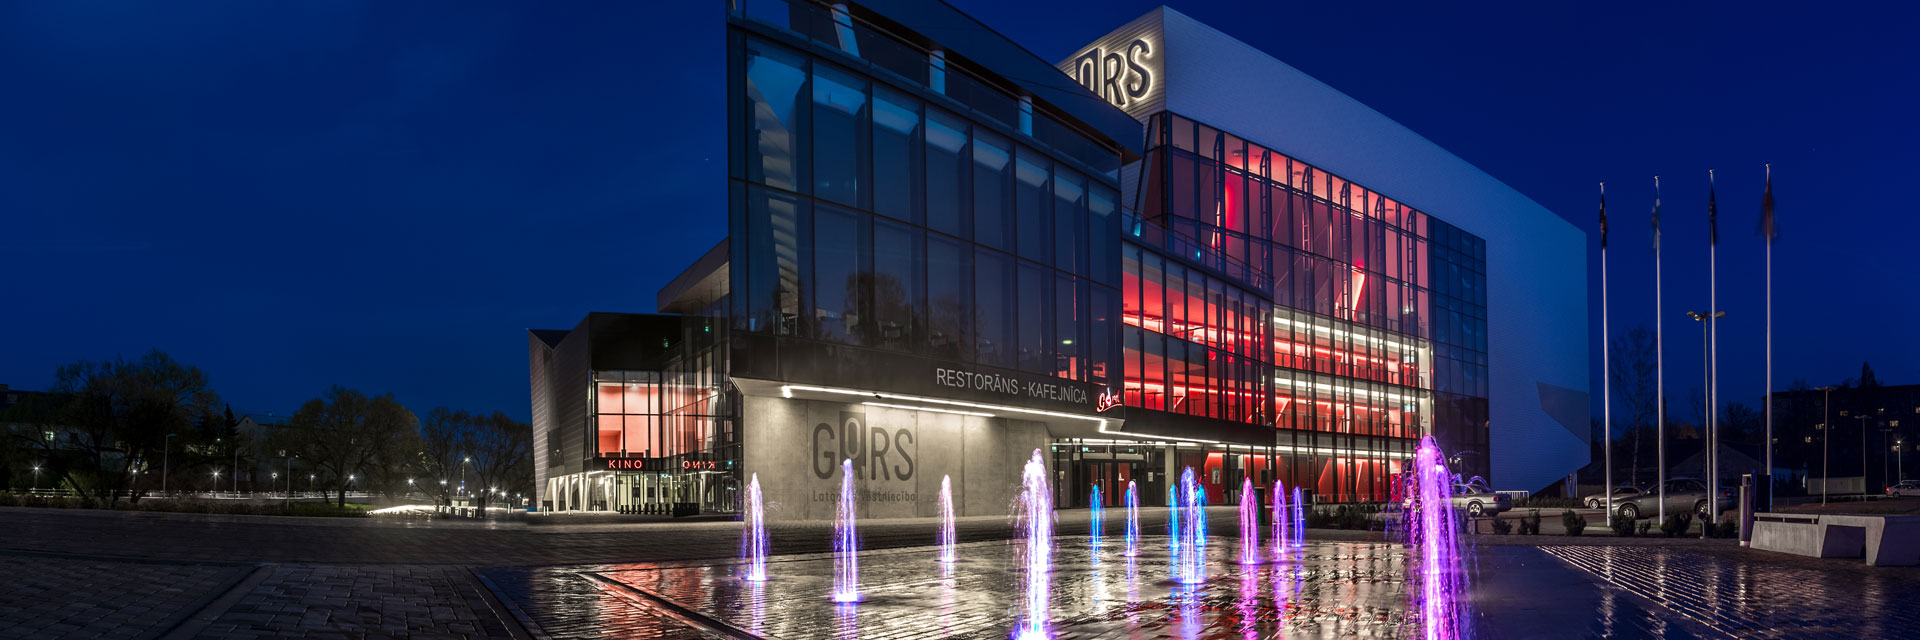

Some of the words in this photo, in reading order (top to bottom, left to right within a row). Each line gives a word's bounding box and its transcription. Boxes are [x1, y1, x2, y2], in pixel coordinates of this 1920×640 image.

[1075, 38, 1152, 107] ORS
[936, 367, 1019, 395] RESTORĀNS
[1028, 381, 1088, 404] KAFEJNĪCA
[608, 459, 643, 469] KINO
